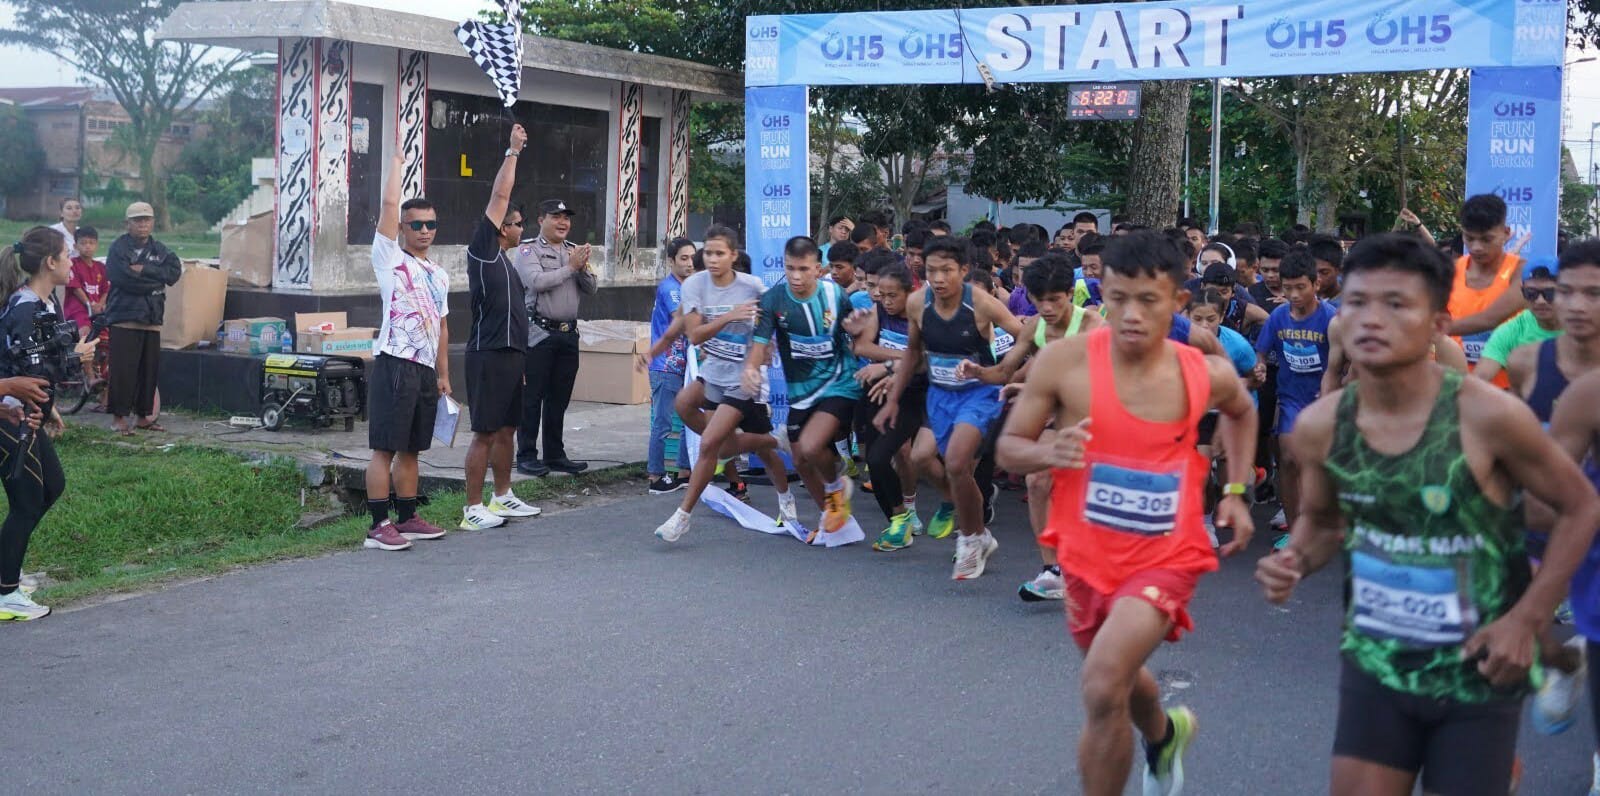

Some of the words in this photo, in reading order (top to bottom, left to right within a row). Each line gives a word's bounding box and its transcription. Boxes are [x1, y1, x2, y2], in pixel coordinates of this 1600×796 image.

[751, 26, 778, 38] OH5
[1266, 19, 1347, 49] OH5
[1366, 13, 1452, 46] OH5
[1516, 24, 1559, 41] RUN
[899, 31, 964, 59] OH5
[985, 5, 1244, 71] START
[821, 33, 884, 60] OH5
[748, 57, 777, 69] RUN
[1494, 101, 1536, 117] OH5
[762, 114, 790, 128] OH5
[1492, 120, 1535, 138] FUN
[760, 130, 790, 146] FUN
[1490, 138, 1534, 154] RUN
[761, 145, 790, 158] RUN
[1491, 155, 1534, 168] 10KM
[762, 184, 791, 197] OH5
[761, 200, 791, 215] FUN
[1506, 207, 1532, 224] UN
[761, 215, 791, 227] RUN
[763, 255, 784, 268] OH
[1094, 487, 1174, 512] CD-309
